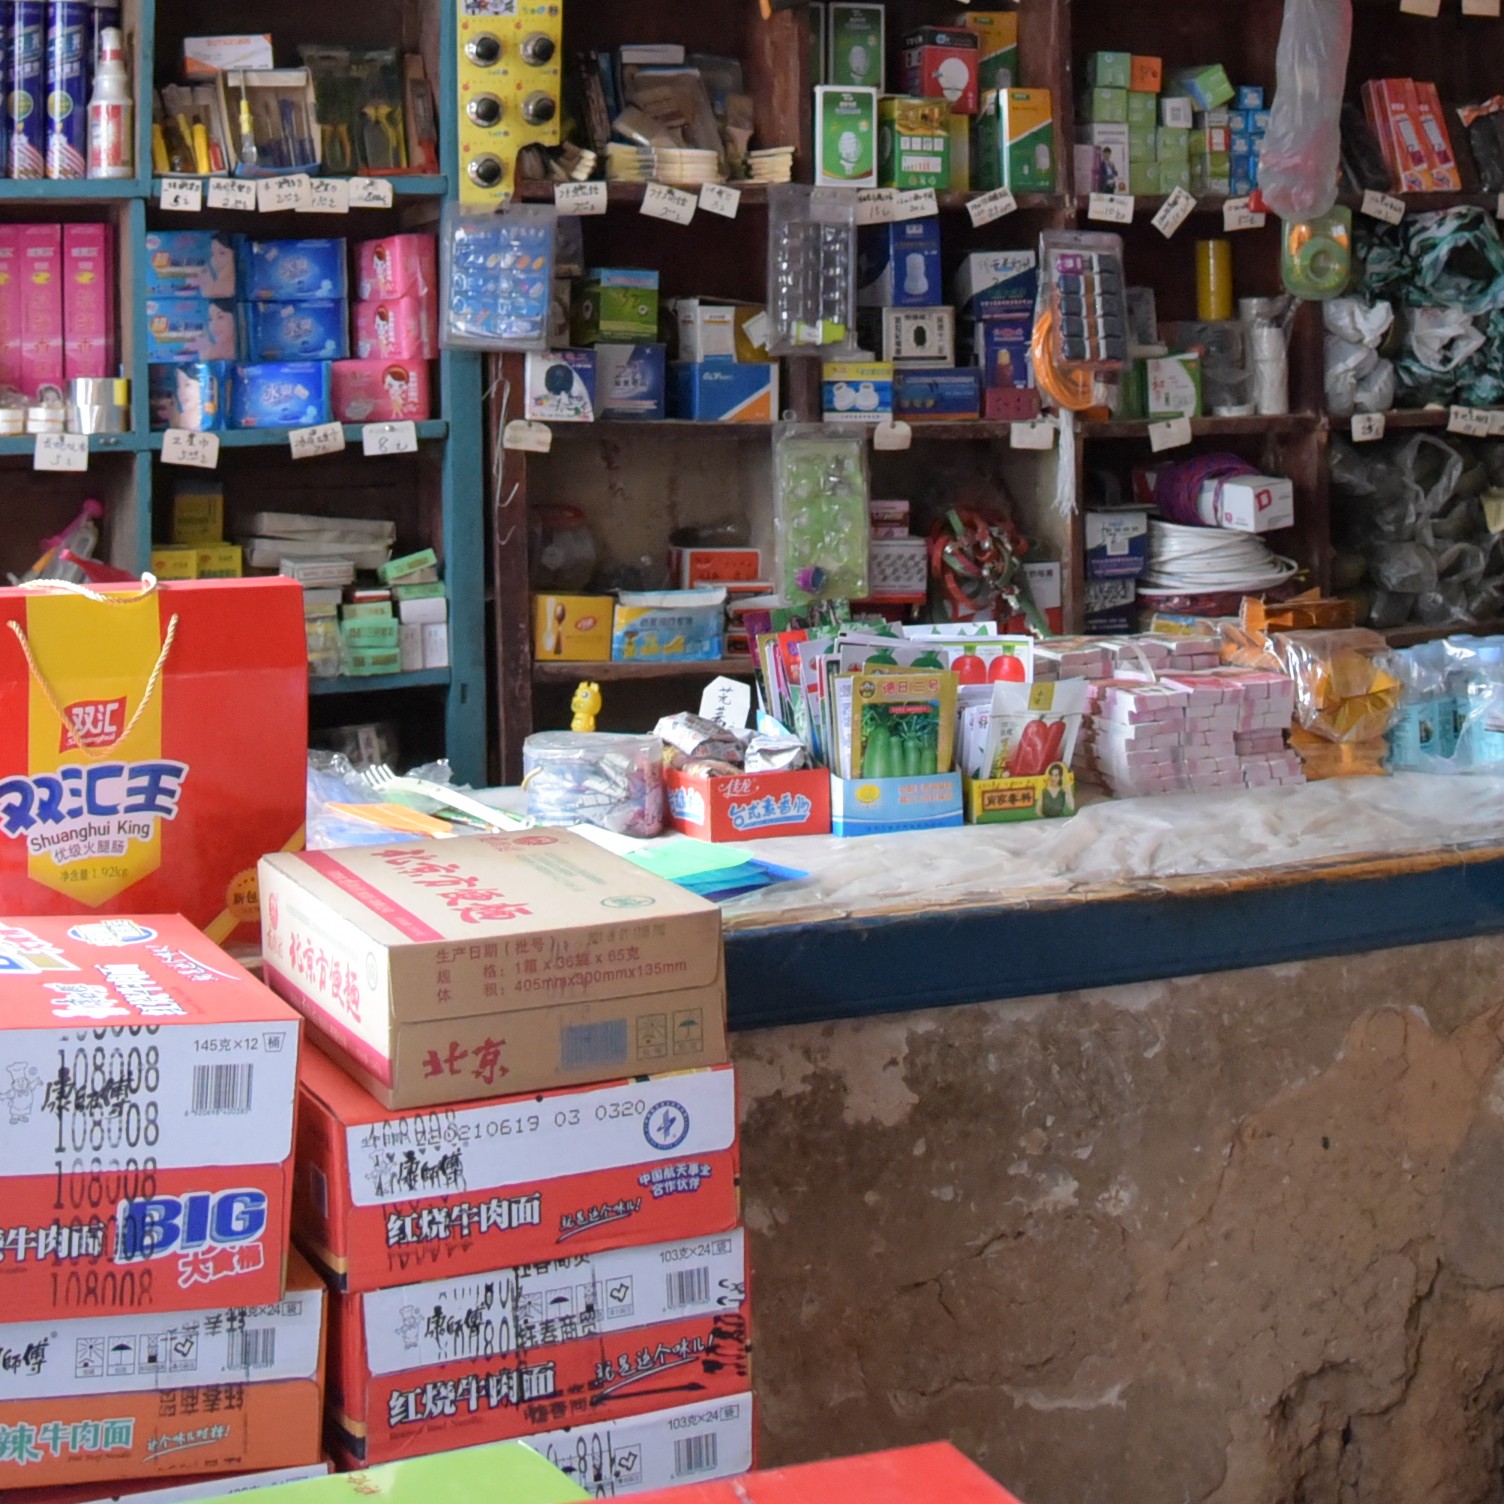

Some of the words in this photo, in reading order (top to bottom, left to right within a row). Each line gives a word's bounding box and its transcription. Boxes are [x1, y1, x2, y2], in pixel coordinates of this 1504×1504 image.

[67, 702, 119, 738] 双汇
[727, 793, 812, 829] 台式素香肠
[30, 823, 111, 853] Shuanghui
[116, 821, 151, 839] King
[53, 839, 126, 863] 优级火腿肠
[59, 866, 89, 882] 净含量
[91, 865, 129, 881] 1.92kg
[436, 943, 497, 964] 生产日期
[436, 986, 453, 1004] 体
[421, 1038, 509, 1085] 北京
[595, 1099, 646, 1123] 0320
[637, 1161, 712, 1188] 中国航天事业
[651, 1177, 702, 1196] 合作伙伴
[122, 1191, 268, 1259] BIG
[386, 1192, 541, 1247] 红烧牛肉面
[388, 1362, 556, 1425] 红烧牛肉面
